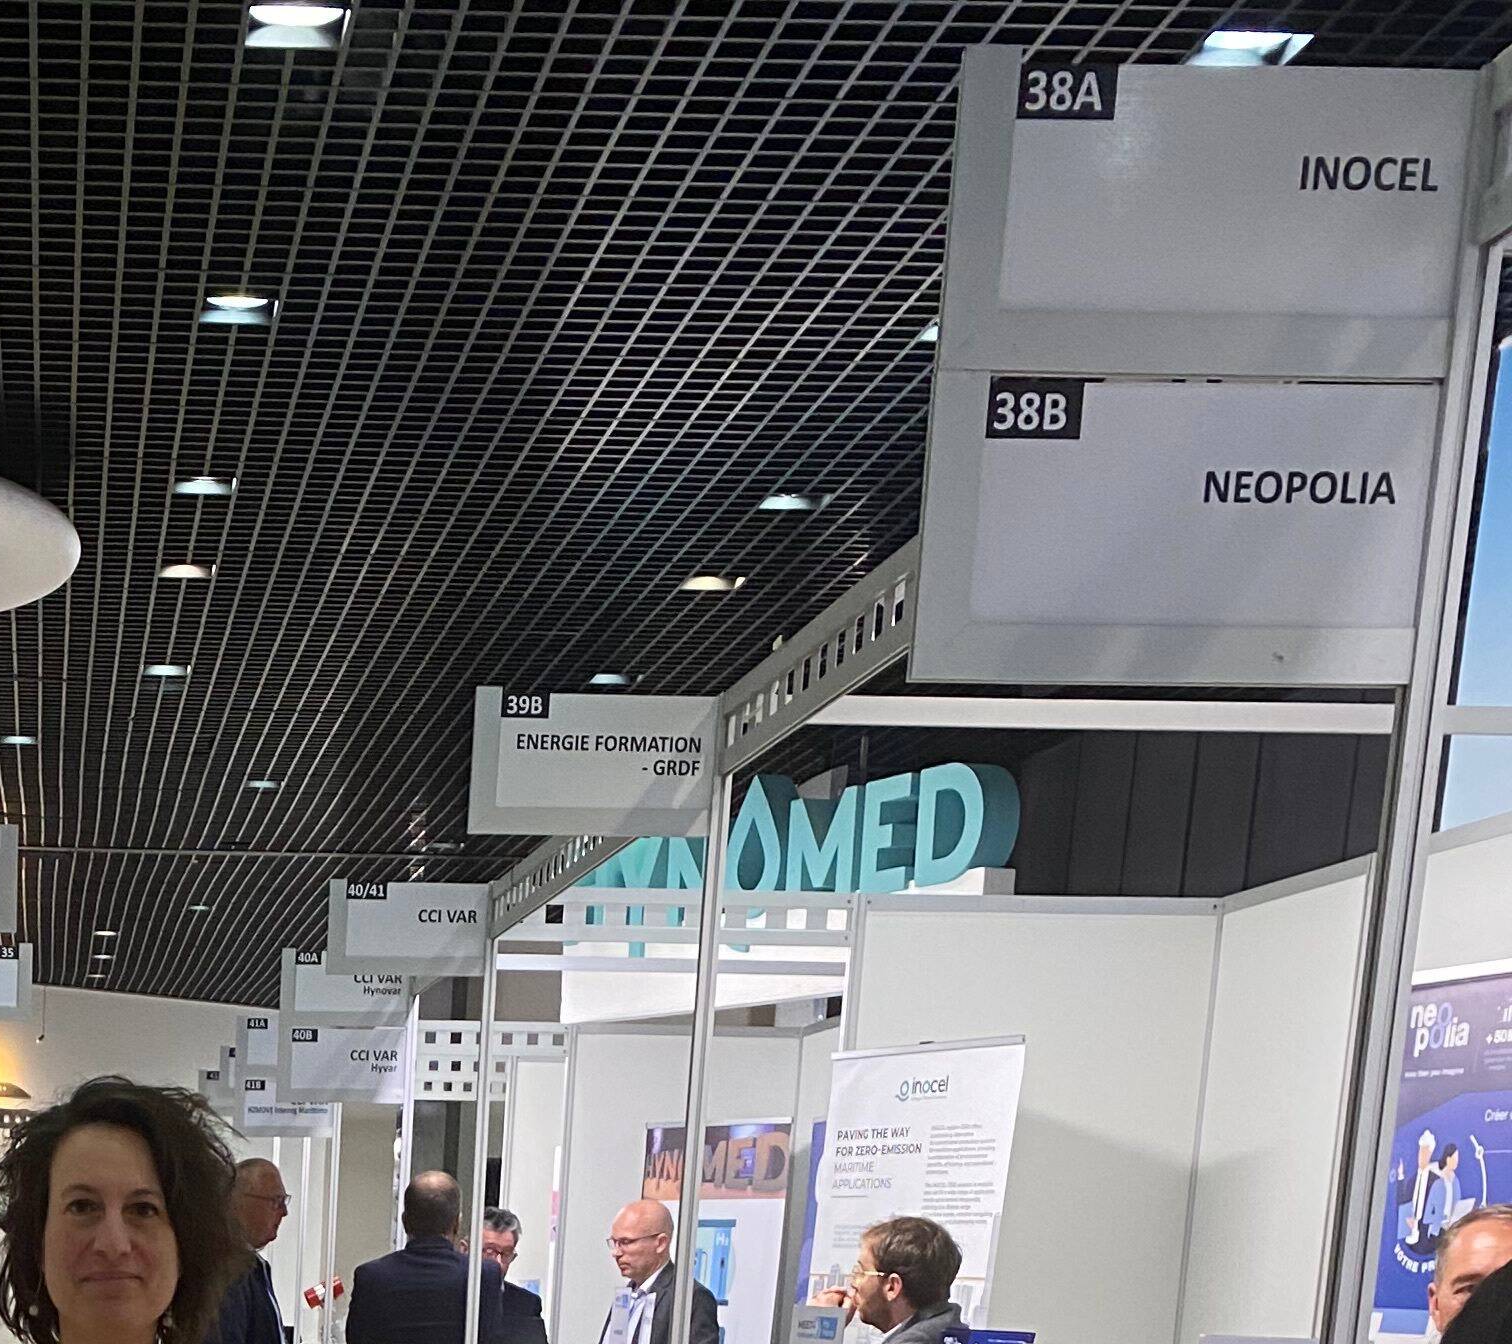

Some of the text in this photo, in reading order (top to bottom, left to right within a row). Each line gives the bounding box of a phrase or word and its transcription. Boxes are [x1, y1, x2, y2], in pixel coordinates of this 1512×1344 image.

[1024, 70, 1102, 112] 38A
[1298, 155, 1439, 192] INOCEL
[993, 392, 1067, 432] 38B
[1202, 470, 1397, 505] NEOPOLIA
[506, 695, 543, 715] 39B
[516, 734, 701, 753] ENERGIE FORMATION
[653, 760, 701, 776] GRDF
[348, 883, 385, 898] 40/41
[418, 909, 477, 923] CCI VAR
[1, 947, 14, 958] 35
[298, 952, 319, 963] 40A
[1410, 1002, 1453, 1028] neo
[292, 1030, 313, 1040] 40B
[1413, 1017, 1470, 1058] polia
[350, 1050, 398, 1061] CCI VAR
[912, 1075, 949, 1094] inocel
[837, 1127, 911, 1141] PAVING THE WAY
[836, 1143, 922, 1157] FOR ZERO-EMISSION
[834, 1161, 875, 1174] MARITIME
[832, 1178, 892, 1190] APPLICATIONS
